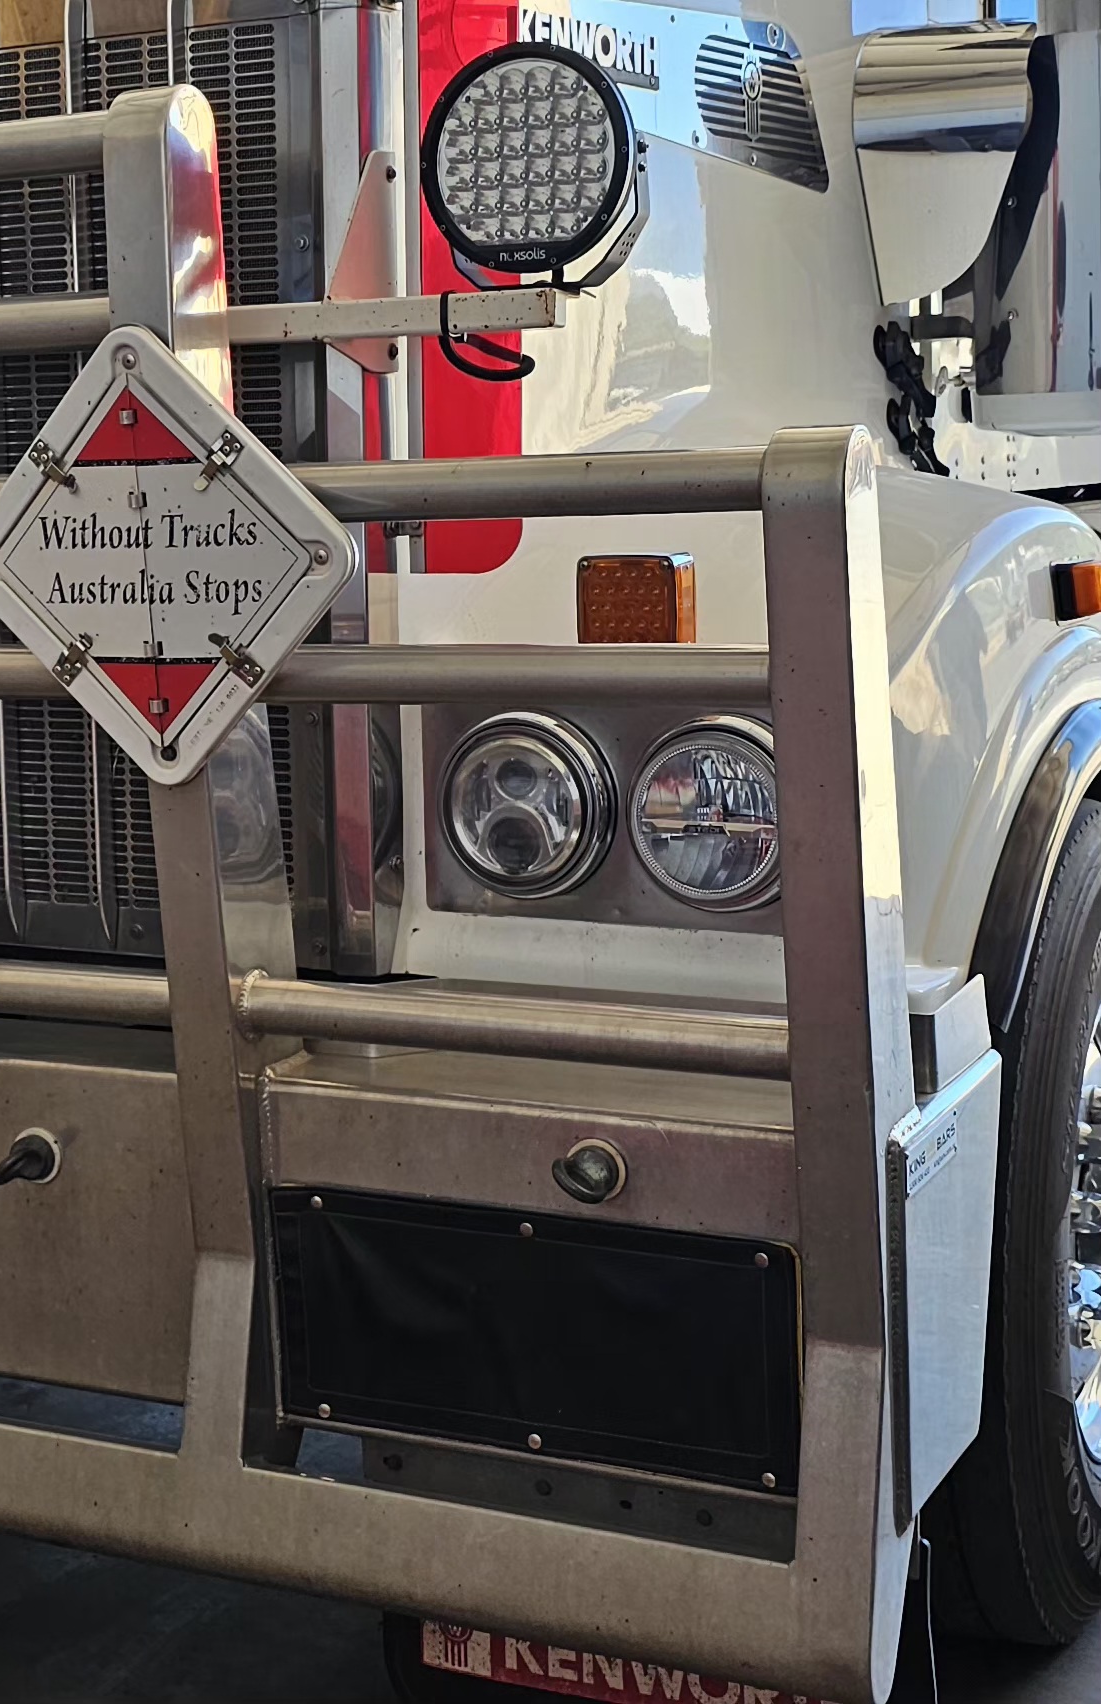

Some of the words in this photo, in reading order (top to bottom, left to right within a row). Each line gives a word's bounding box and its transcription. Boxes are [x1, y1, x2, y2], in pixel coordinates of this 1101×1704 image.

[518, 8, 659, 77] KENWORTH
[38, 513, 153, 551] Without
[160, 508, 258, 548] Trucks
[46, 571, 174, 606] Australia
[184, 570, 263, 616] Stops
[908, 1150, 926, 1177] KING
[936, 1122, 957, 1152] BARS
[503, 1636, 844, 1704] KENWO
